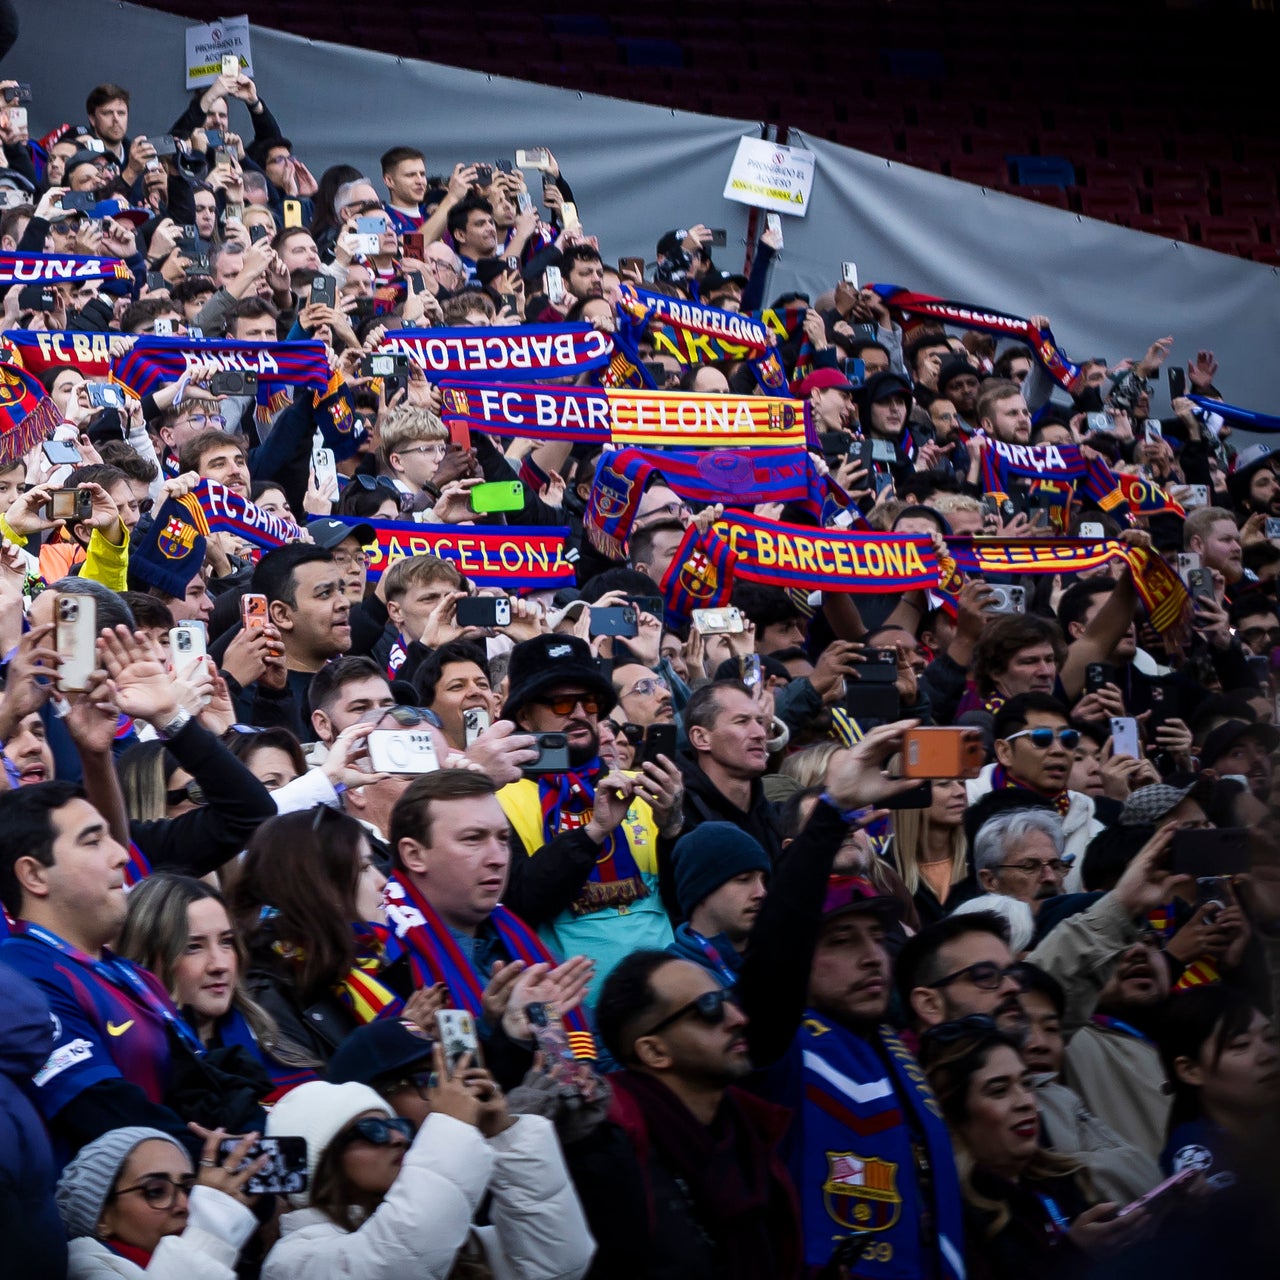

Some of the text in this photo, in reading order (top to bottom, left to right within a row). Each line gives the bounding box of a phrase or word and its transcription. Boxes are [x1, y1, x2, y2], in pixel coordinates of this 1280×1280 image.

[647, 297, 765, 345] FC BARCELONA
[36, 333, 71, 363] FC
[480, 390, 758, 433] FC BARCELONA
[206, 480, 237, 519] FC
[753, 529, 928, 577] BARCELONA
